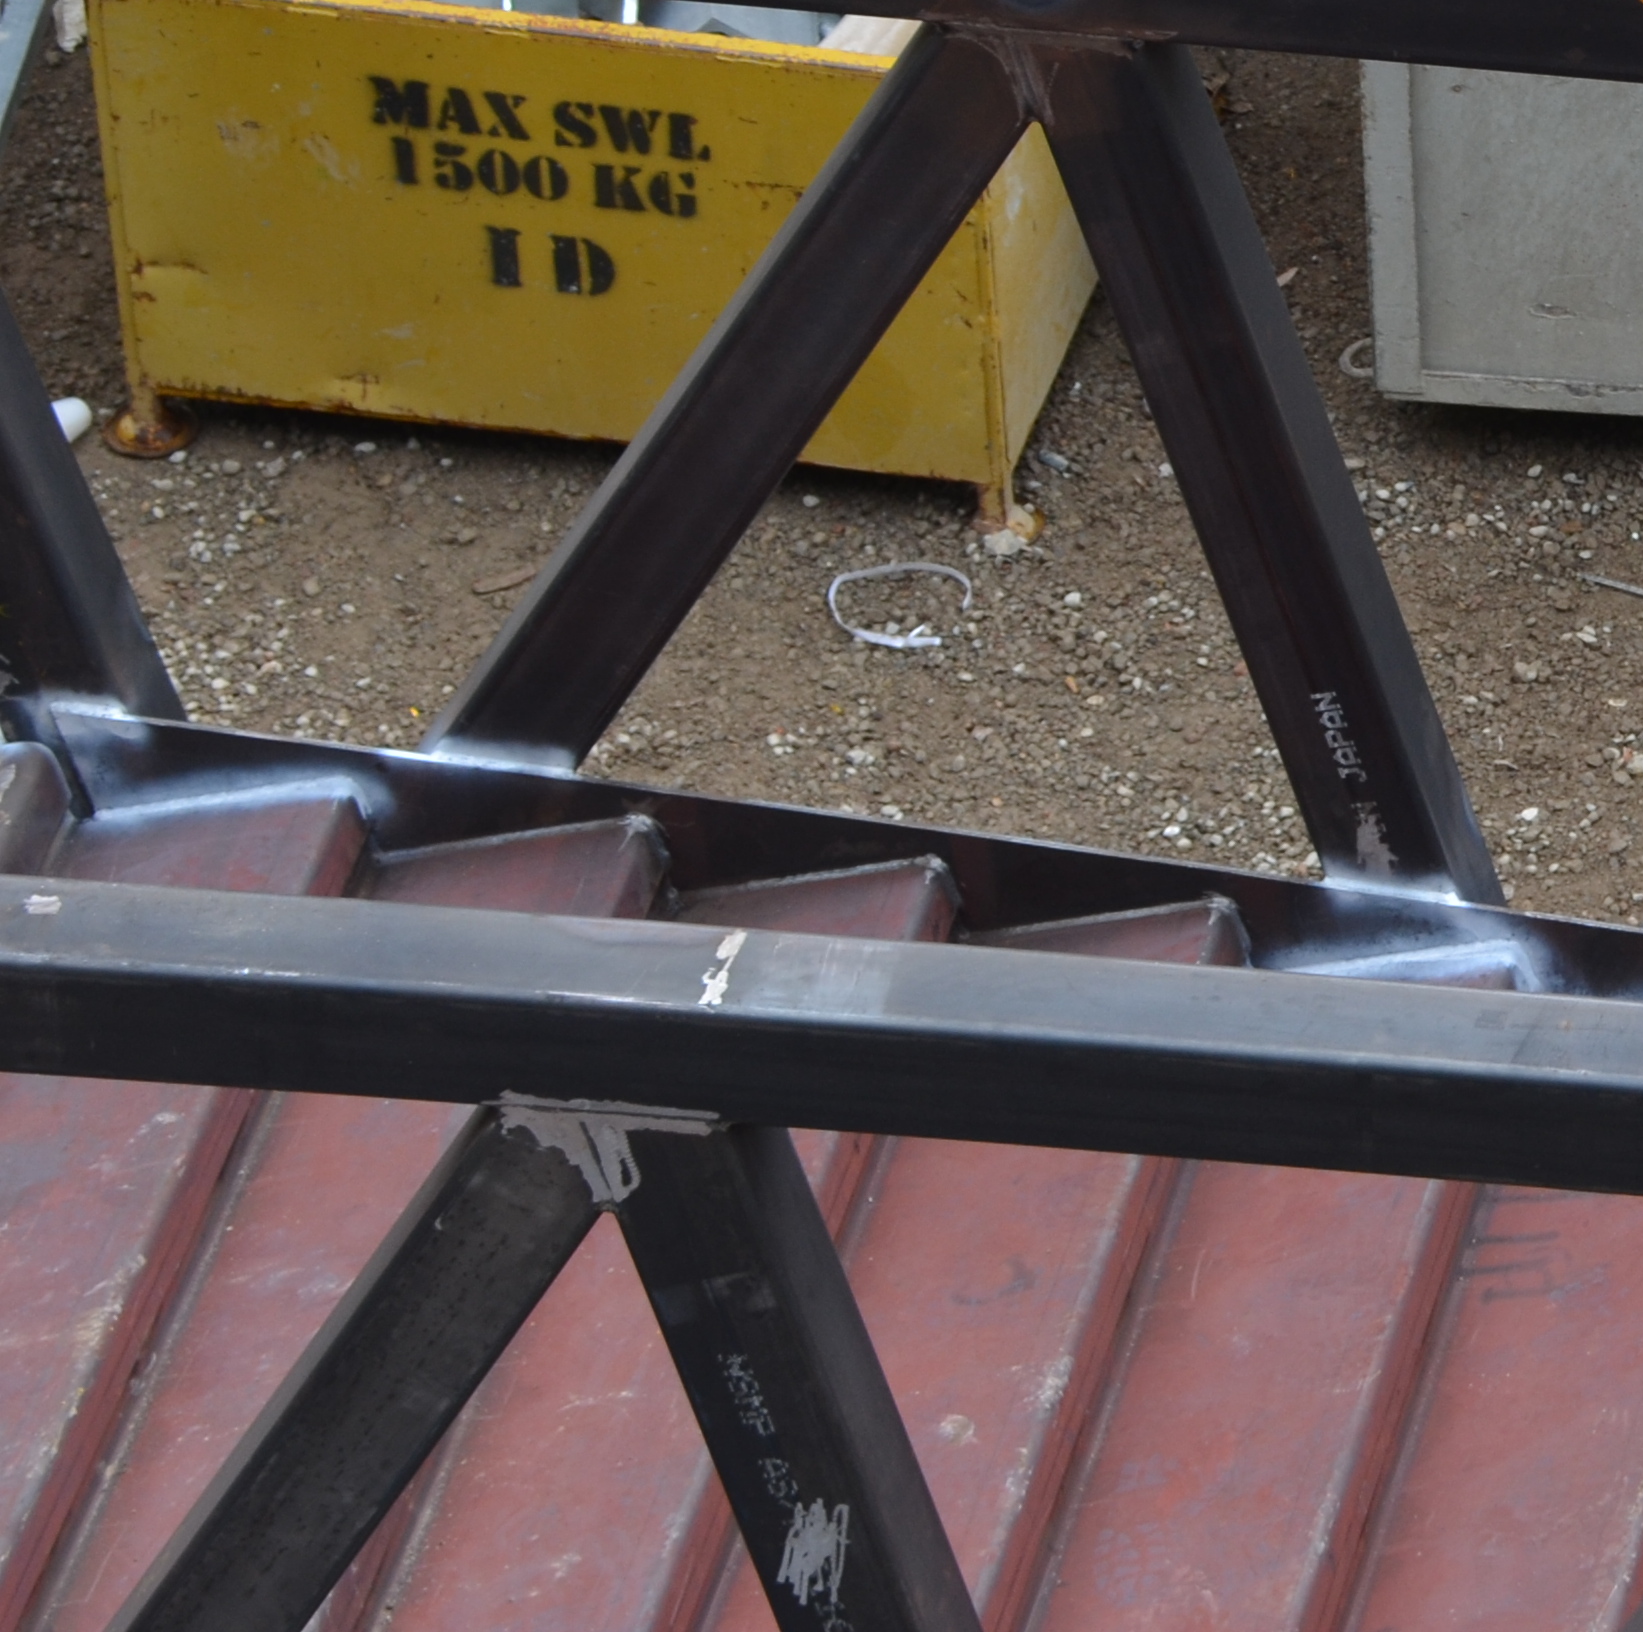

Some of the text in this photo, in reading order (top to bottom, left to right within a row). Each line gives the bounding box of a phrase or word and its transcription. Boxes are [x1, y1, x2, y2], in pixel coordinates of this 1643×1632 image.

[368, 75, 712, 162] MAX SWL
[391, 136, 697, 218] 1500 KG
[1310, 691, 1368, 783] JAPAN
